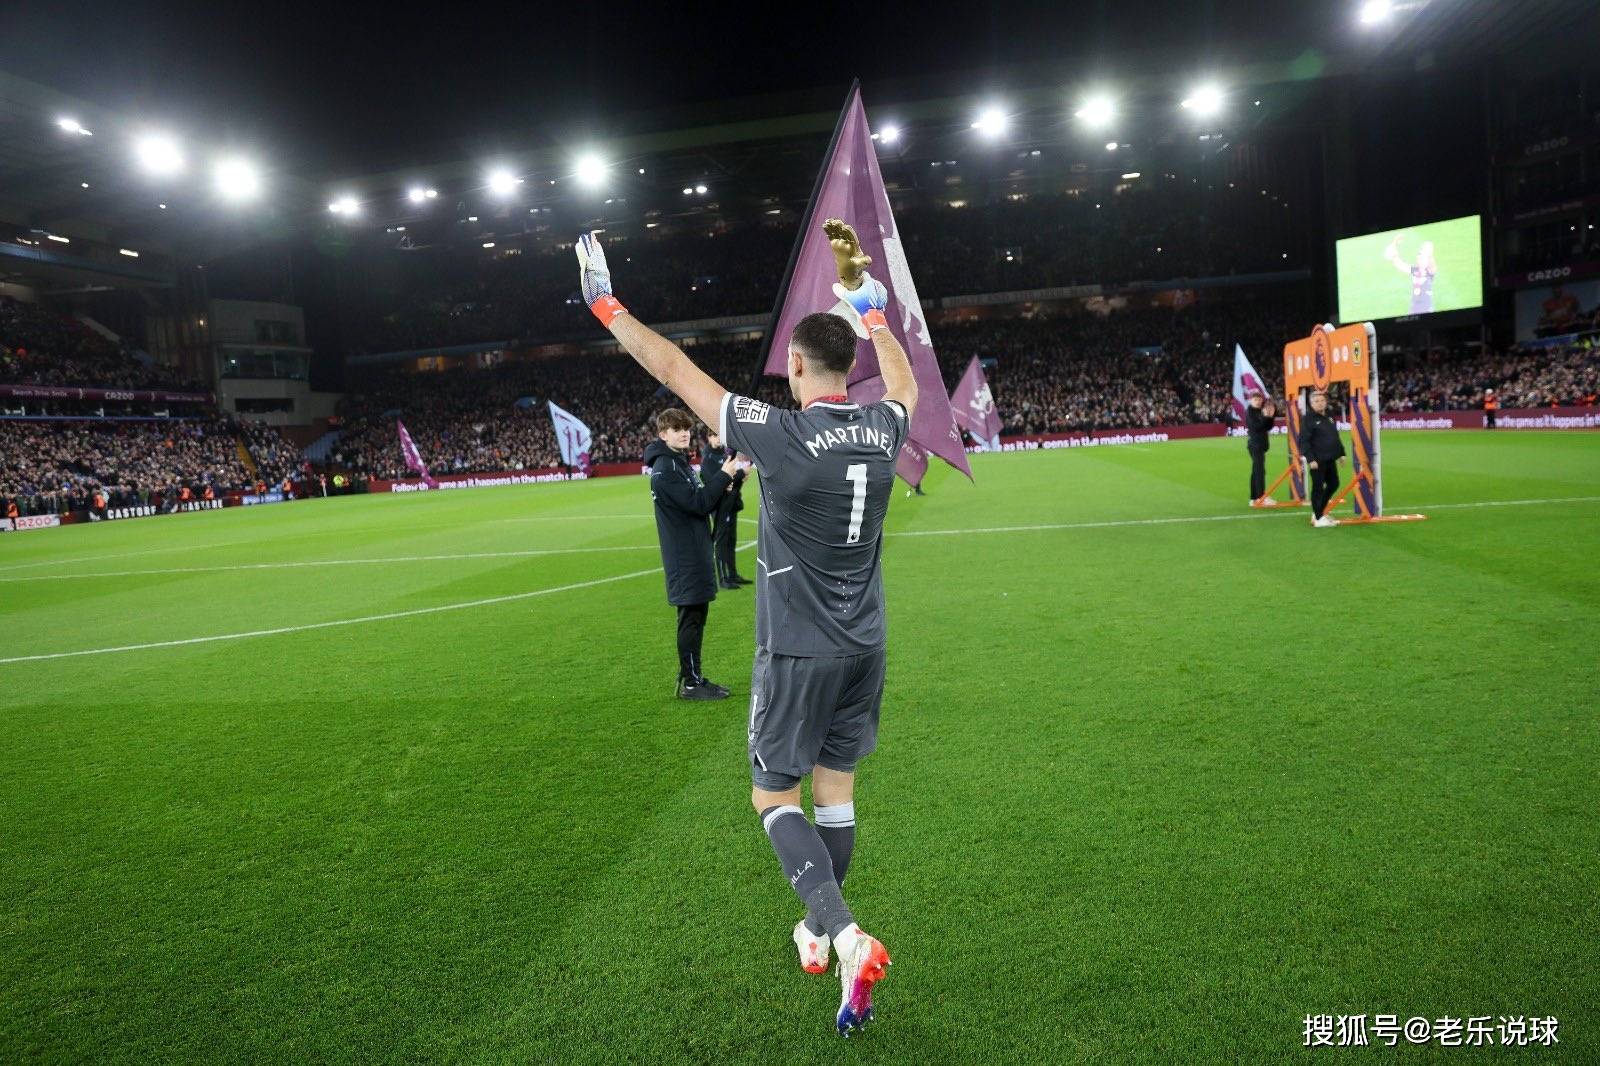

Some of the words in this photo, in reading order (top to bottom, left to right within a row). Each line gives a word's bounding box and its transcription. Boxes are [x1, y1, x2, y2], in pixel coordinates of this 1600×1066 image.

[1025, 439, 1069, 450] hapens
[1070, 436, 1080, 448] in
[1100, 434, 1133, 446] match
[1134, 432, 1168, 443] centre
[475, 477, 511, 488] happens
[511, 474, 520, 485] in
[521, 473, 536, 484] the
[537, 472, 564, 483] match
[846, 463, 868, 543] 1
